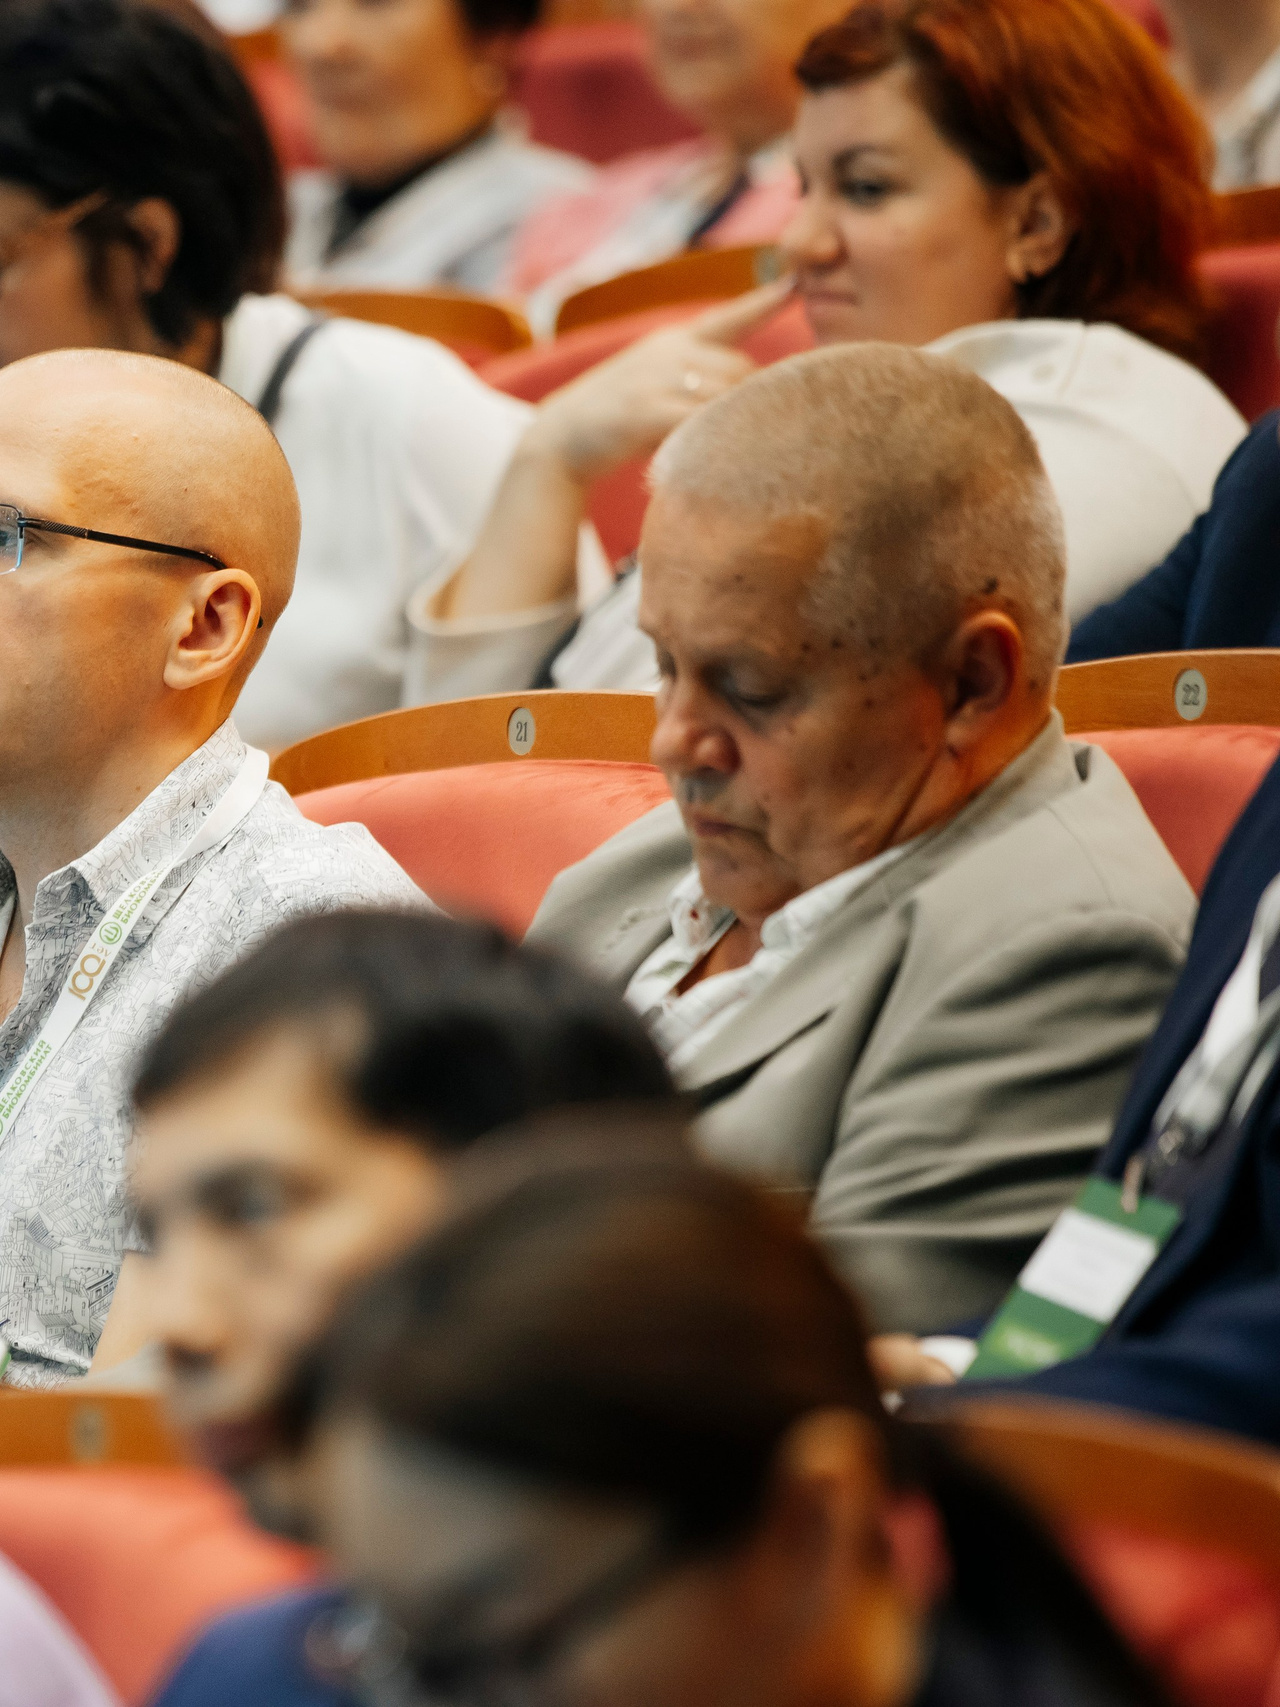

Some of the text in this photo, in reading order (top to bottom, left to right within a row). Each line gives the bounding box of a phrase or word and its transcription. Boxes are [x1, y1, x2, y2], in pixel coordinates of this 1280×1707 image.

[1183, 684, 1200, 705] 22
[516, 721, 527, 742] 21
[69, 954, 106, 1001] 100
[2, 1044, 52, 1120] БИОКОМБИНАТ
